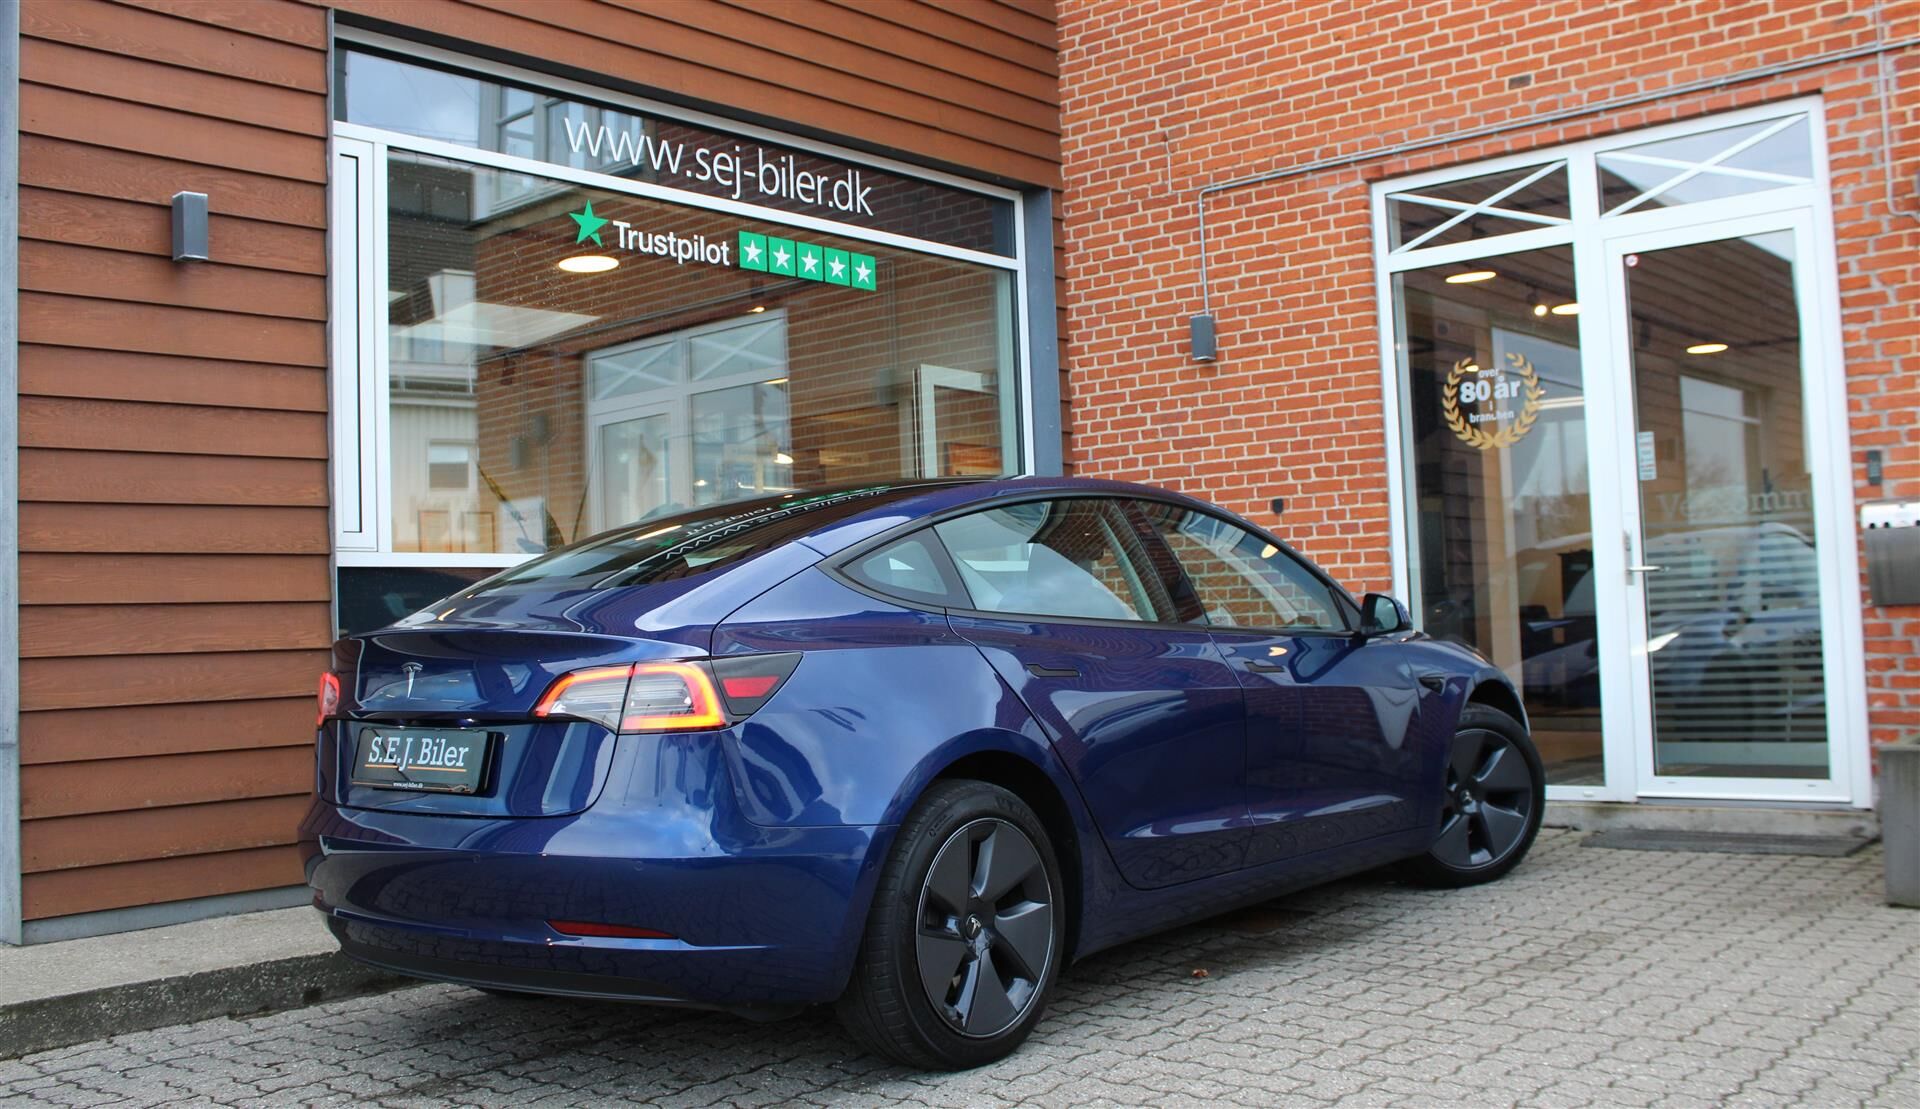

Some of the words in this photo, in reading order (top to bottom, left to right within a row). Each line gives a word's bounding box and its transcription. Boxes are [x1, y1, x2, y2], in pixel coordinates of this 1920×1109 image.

[564, 117, 874, 216] www.sej-biler.dk
[613, 220, 731, 267] Trustpilot
[1460, 379, 1491, 403] 80
[1494, 376, 1521, 399] år
[368, 737, 413, 771] S.E.J.
[417, 737, 469, 767] Biler
